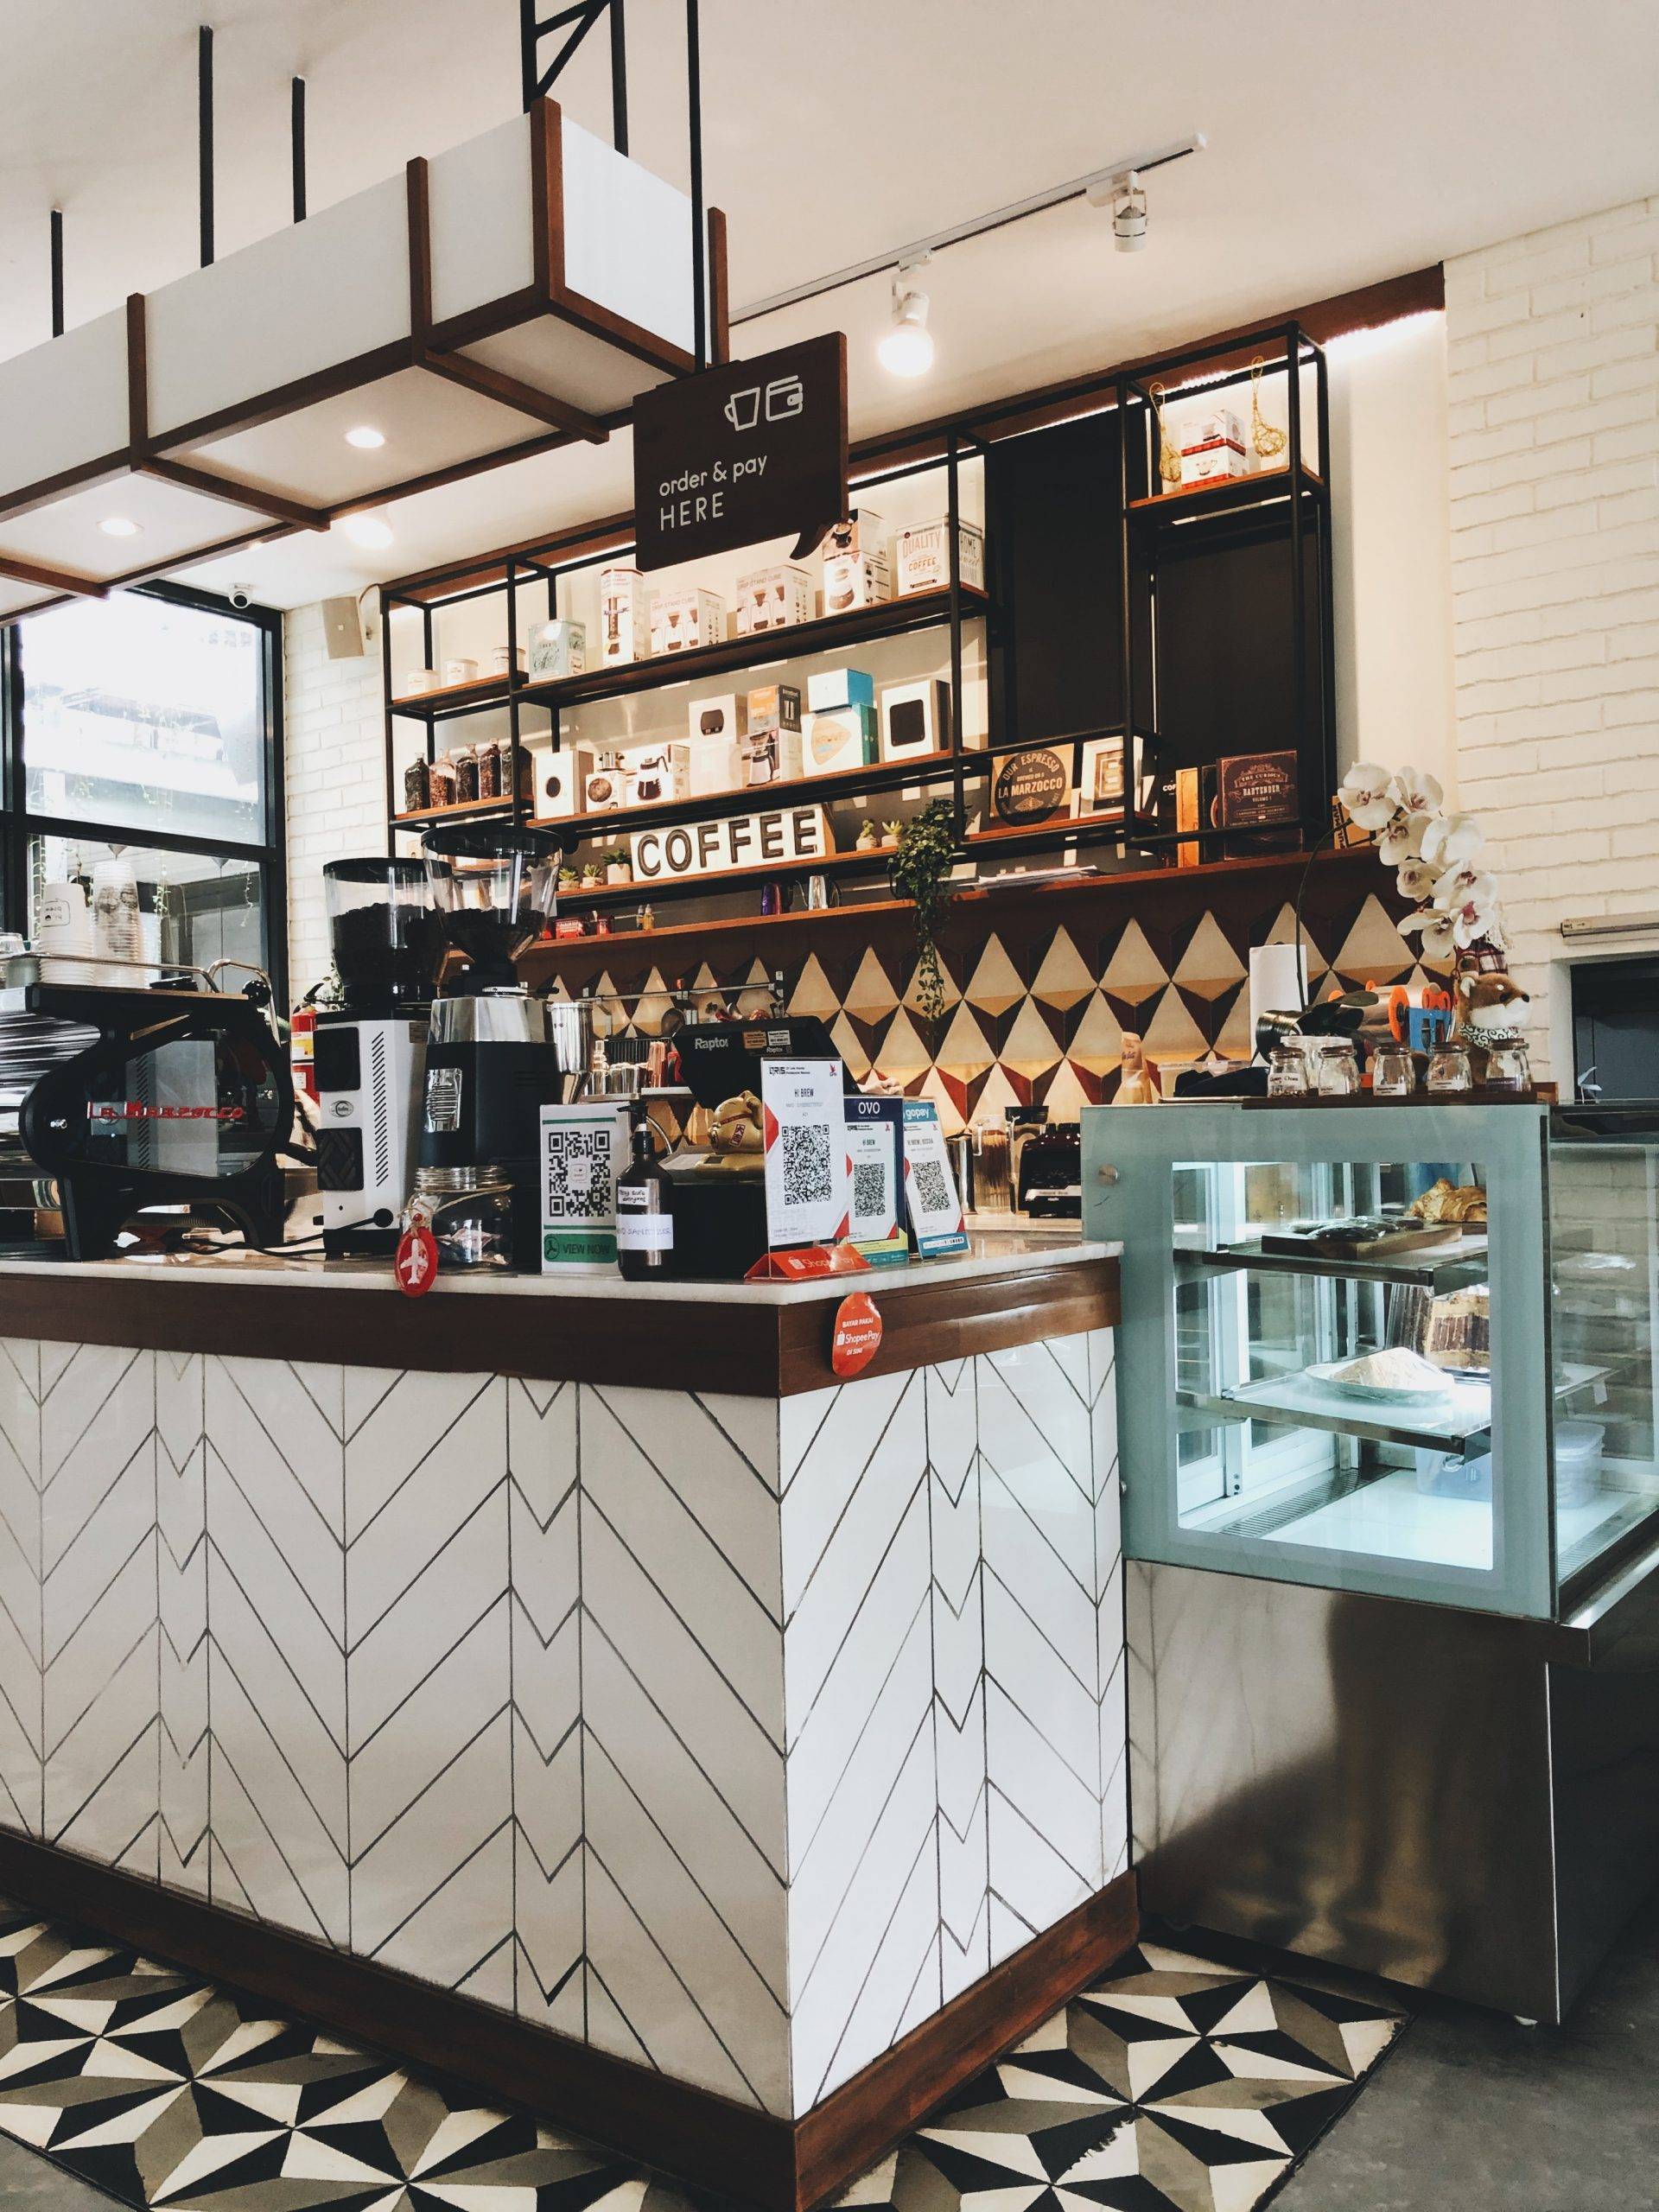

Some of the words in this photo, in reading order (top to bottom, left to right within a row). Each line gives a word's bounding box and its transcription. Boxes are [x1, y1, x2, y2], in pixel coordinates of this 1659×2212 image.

[659, 470, 708, 497] order
[712, 461, 728, 482] &
[733, 454, 767, 483] pay
[660, 492, 724, 531] HERE
[903, 530, 940, 558] QUALITY
[908, 556, 937, 571] COFFEE
[1003, 763, 1018, 780] OUR
[1020, 753, 1059, 772] ESPRESSO
[998, 786, 1008, 798] LA
[1011, 777, 1063, 797] MARZOCCO
[1243, 785, 1281, 796] BARTENDER
[637, 810, 816, 876] COFFEE
[800, 1088, 814, 1097] BREW
[858, 1102, 880, 1115] OVO
[905, 1108, 930, 1120] gopay
[563, 1244, 585, 1255] VIEW
[588, 1244, 611, 1255] NOW
[842, 1319, 858, 1328] BAYAR
[845, 1330, 880, 1344] ShopeePay
